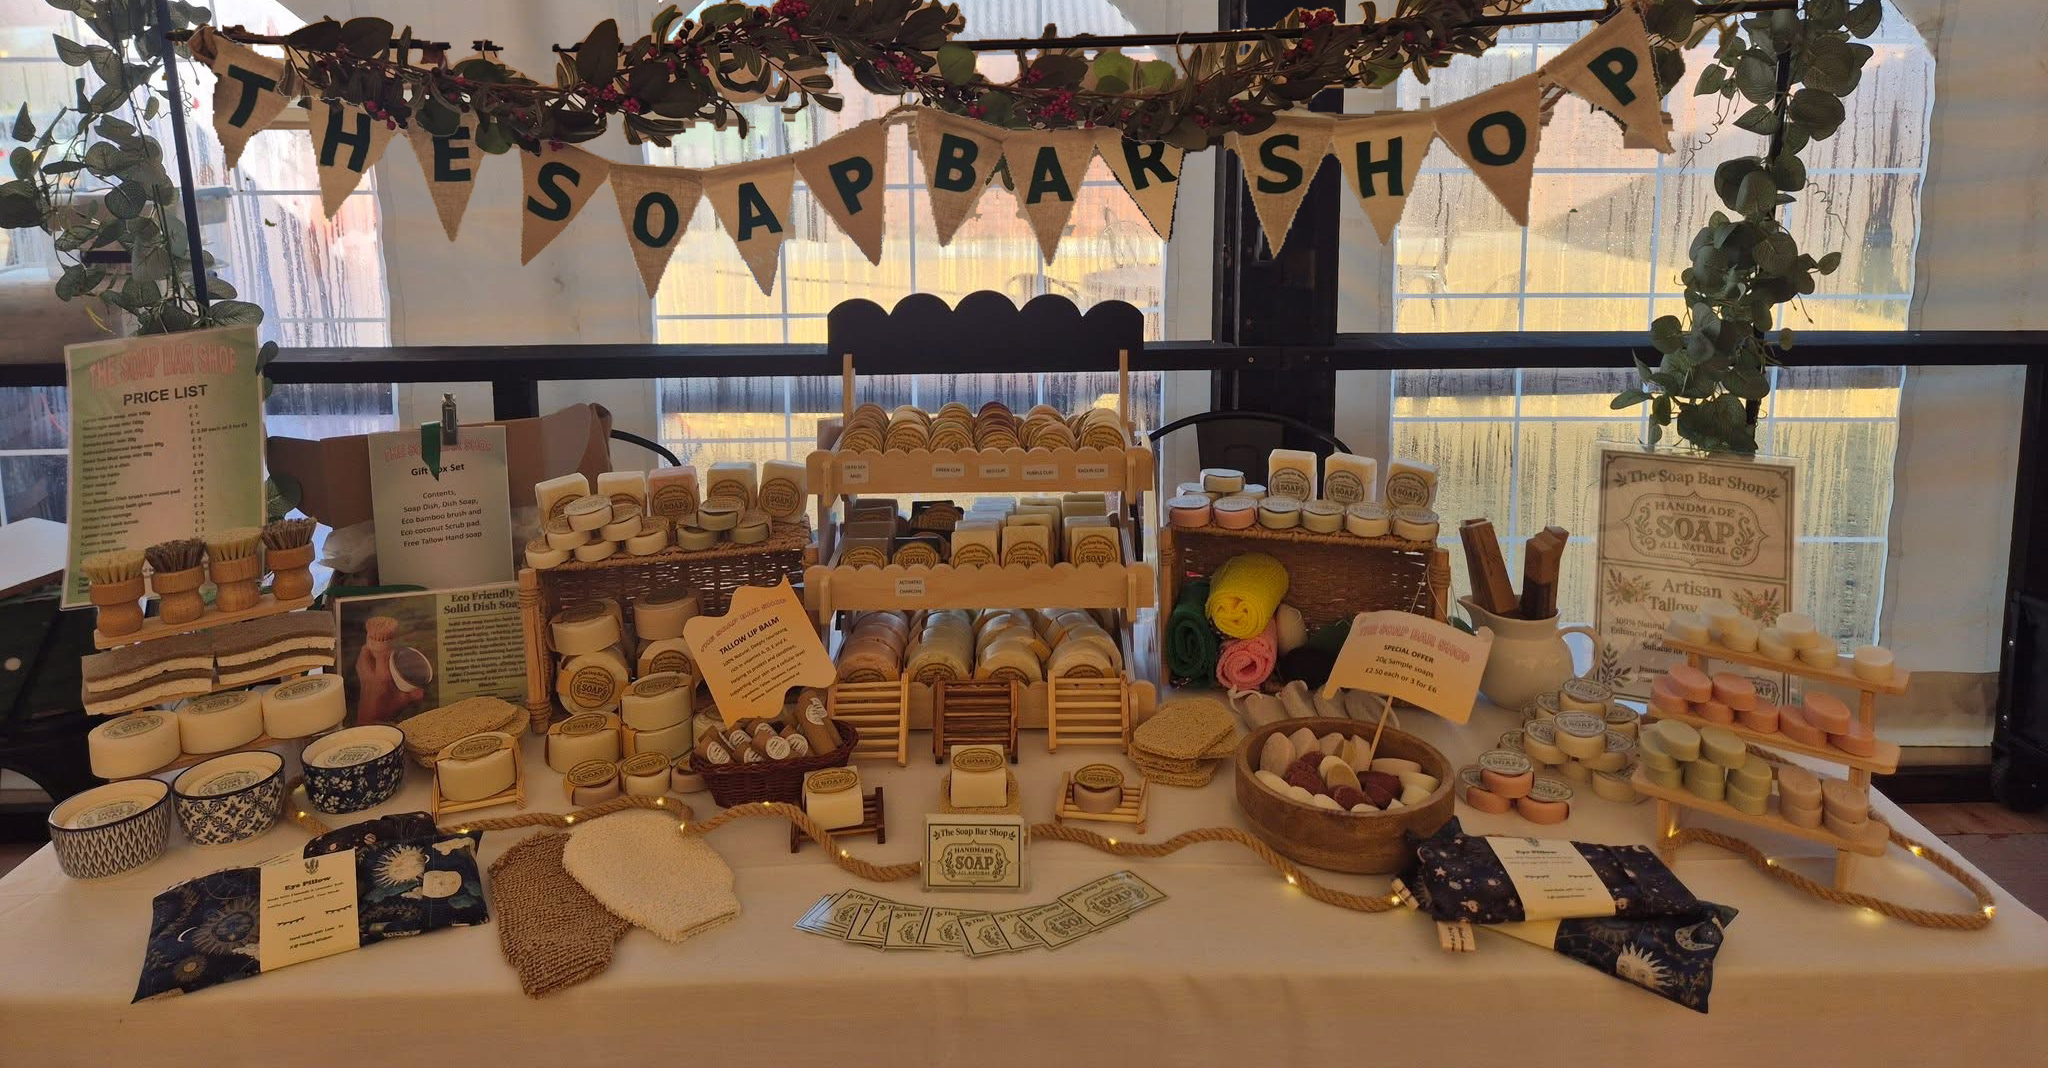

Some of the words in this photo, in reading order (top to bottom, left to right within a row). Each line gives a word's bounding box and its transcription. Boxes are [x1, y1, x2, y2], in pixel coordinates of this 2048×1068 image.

[527, 155, 874, 248] SOAP
[933, 133, 1177, 204] BAR
[1257, 46, 1638, 197] SHOP
[124, 389, 168, 406] PRICE
[175, 385, 208, 398] LIST
[411, 467, 428, 476] Gift
[1280, 484, 1299, 492] SOAP
[1628, 470, 1656, 483] The
[1659, 469, 1694, 486] Soap
[1698, 472, 1725, 487] Bar
[1727, 475, 1766, 496] Shop
[423, 490, 456, 499] Contents,
[404, 504, 421, 513] Soap
[423, 502, 441, 511] Dish,
[443, 500, 458, 508] Dish
[1655, 501, 1736, 518] HANDMADE
[402, 517, 414, 525] Eco
[416, 514, 445, 523] bamboo
[447, 510, 467, 519] brush
[468, 508, 482, 516] and
[415, 525, 443, 534] coconut
[1656, 515, 1735, 545] SOAP
[403, 539, 419, 547] Free
[421, 536, 444, 545] Tallow
[446, 533, 464, 542] Hand
[466, 531, 482, 540] soap
[1660, 540, 1680, 550] ALL
[1682, 543, 1728, 555] NATURAL
[452, 594, 469, 602] Eco
[472, 588, 515, 600] Friendly
[1662, 579, 1722, 599] Artisan
[444, 604, 470, 614] Solid
[473, 601, 496, 611] Dish
[1650, 596, 1698, 613] Tallow
[718, 634, 748, 655] TALLOW
[747, 628, 759, 638] LIP
[758, 616, 780, 632] BALM
[750, 639, 766, 650] Deeply
[1384, 644, 1409, 656] SPECIAL
[1412, 650, 1434, 664] OFFER
[730, 665, 739, 673] rich
[1376, 655, 1387, 664] 20g
[1388, 657, 1413, 670] Sample
[1414, 666, 1434, 678] soaps
[1365, 667, 1383, 676] £2.50
[1384, 669, 1400, 679] each
[1416, 679, 1427, 688] for
[1428, 684, 1437, 694] £6
[582, 685, 602, 694] SOAP
[956, 828, 974, 837] Soap
[989, 828, 1008, 838] Shop
[955, 856, 994, 870] SOAP
[285, 883, 300, 891] Eye
[303, 876, 331, 886] Pillow
[1073, 891, 1082, 899] The
[1100, 890, 1132, 908] SOAP
[1032, 911, 1042, 919] The
[1059, 916, 1082, 929] SOA
